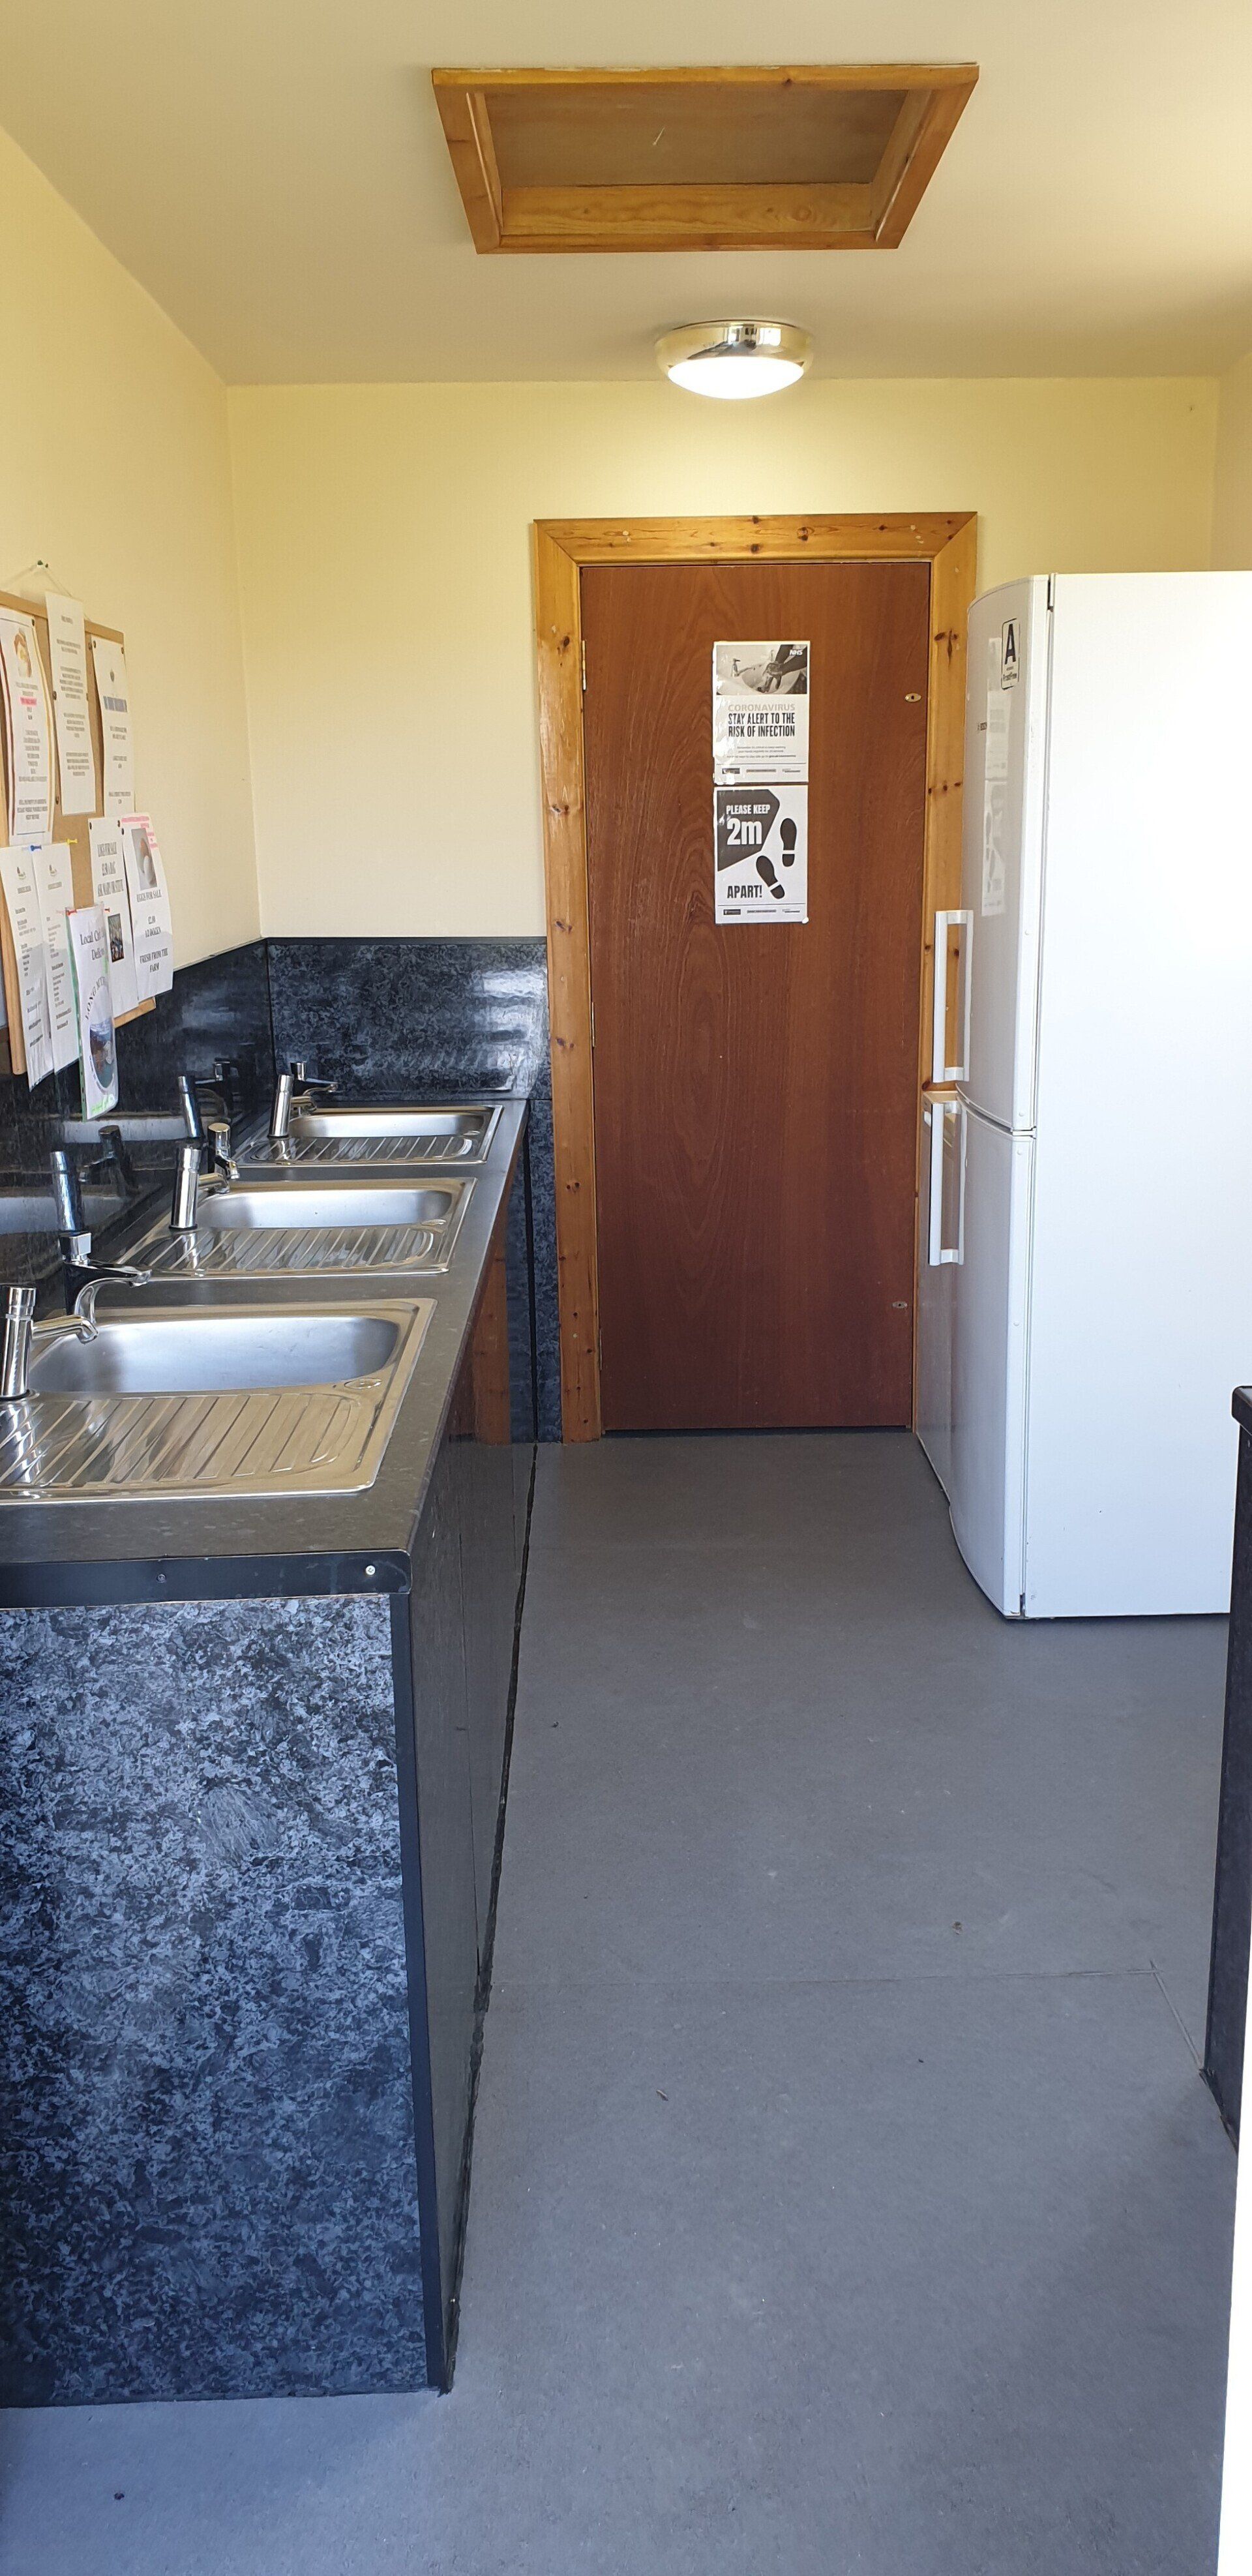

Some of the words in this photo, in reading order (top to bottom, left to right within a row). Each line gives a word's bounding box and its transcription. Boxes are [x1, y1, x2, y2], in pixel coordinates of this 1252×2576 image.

[1005, 623, 1016, 665] A
[728, 713, 745, 725] STAY
[747, 713, 769, 725] ALERT
[771, 713, 779, 724] TO
[782, 712, 795, 724] THE
[728, 726, 745, 737] RISK
[747, 726, 756, 737] OF
[758, 725, 795, 737] INFECTION
[726, 805, 752, 815] PLEASE
[753, 804, 771, 814] KEEP
[726, 818, 762, 845] 2m
[727, 885, 762, 899] APART!
[80, 933, 93, 946] Local
